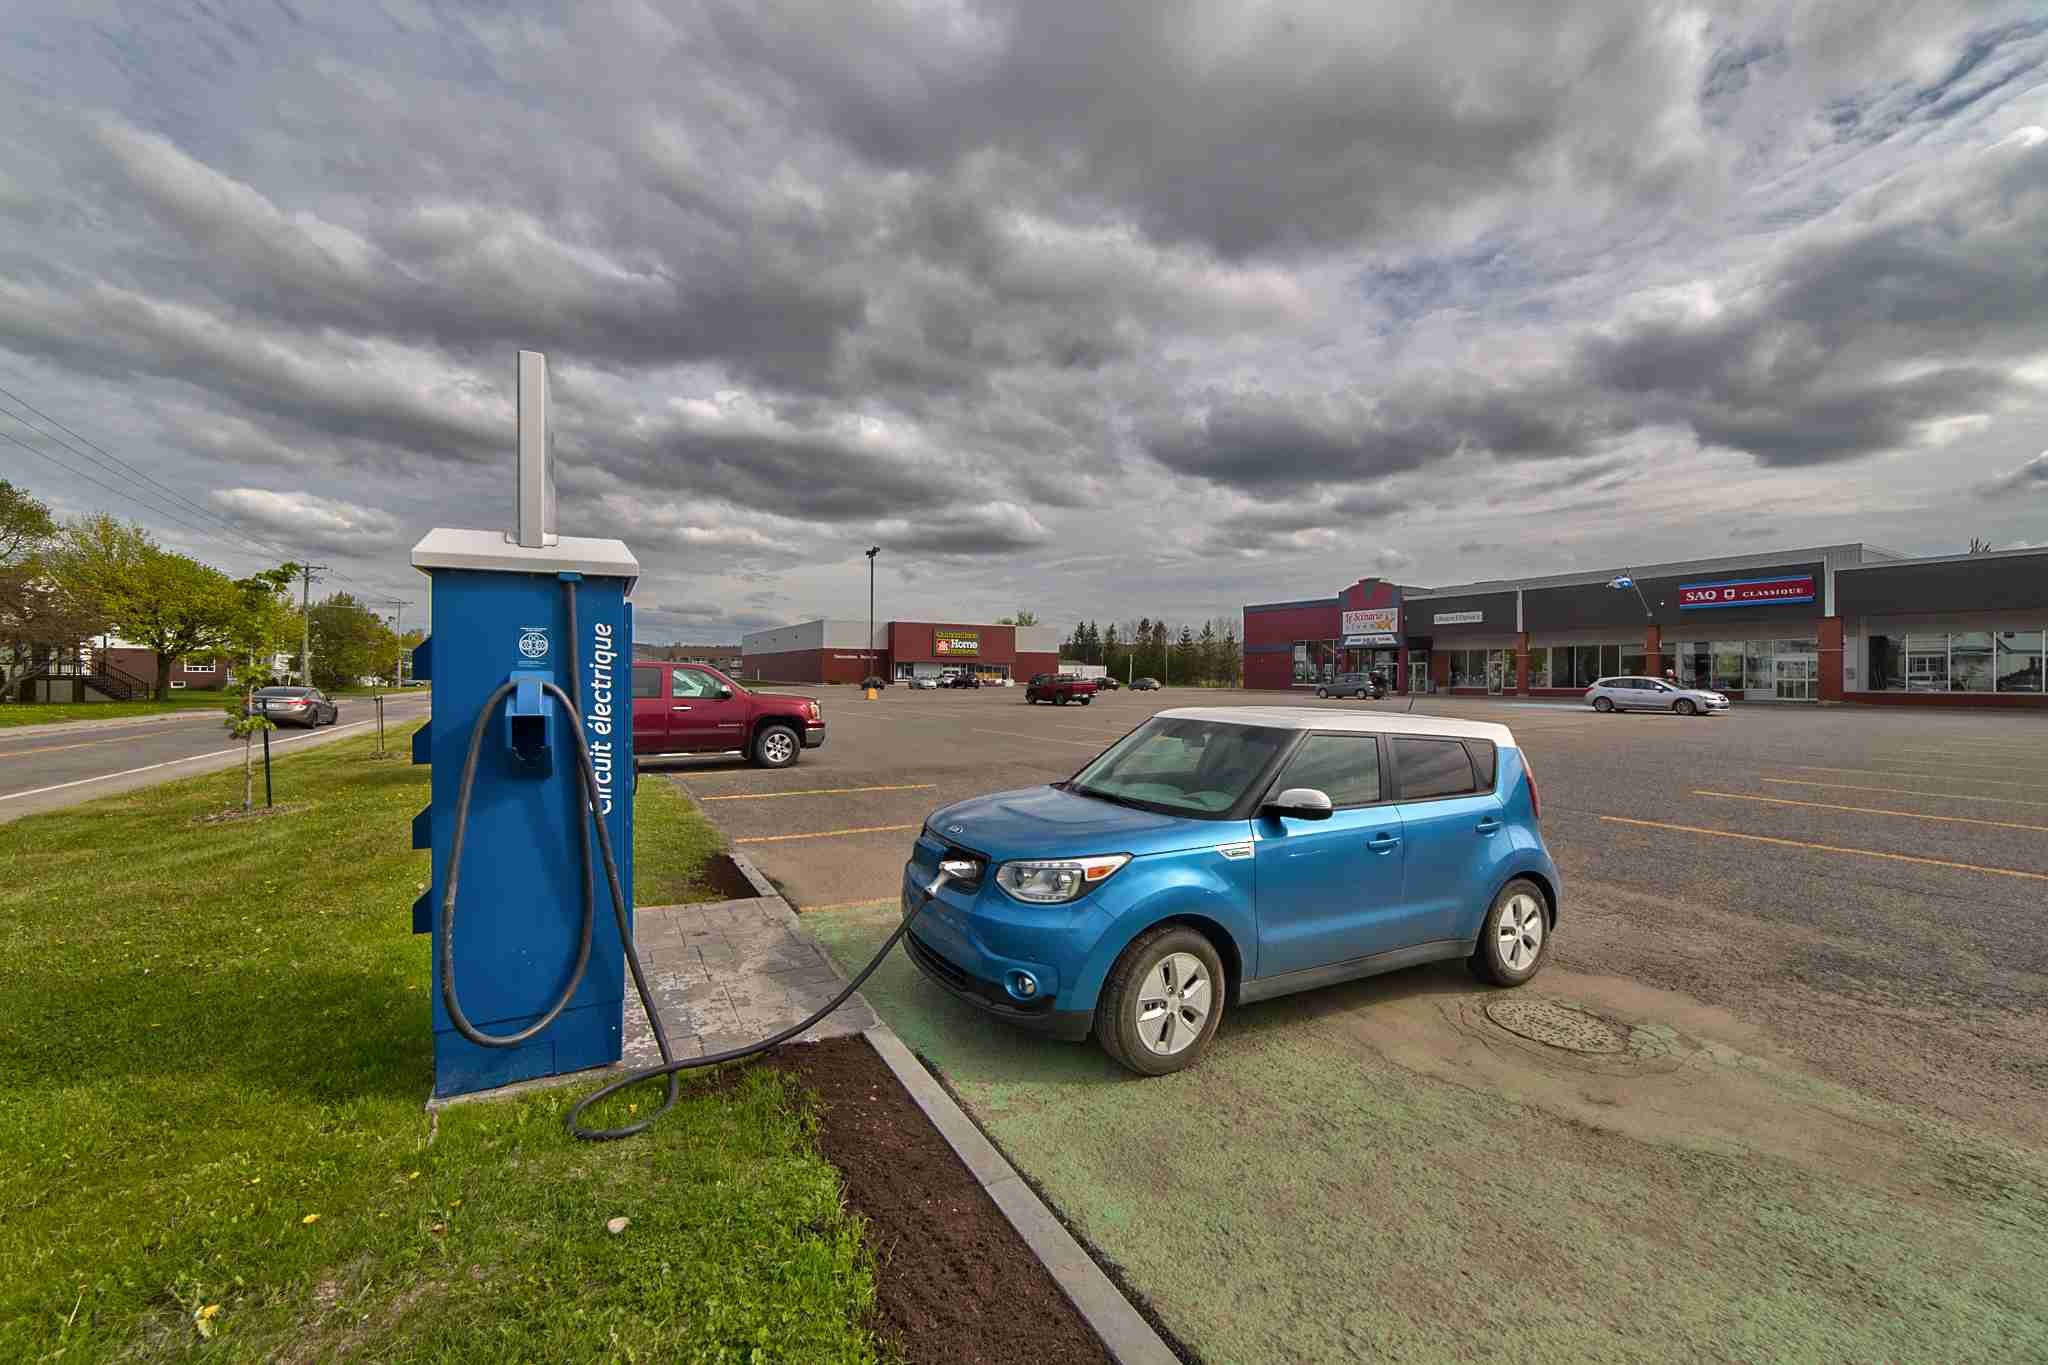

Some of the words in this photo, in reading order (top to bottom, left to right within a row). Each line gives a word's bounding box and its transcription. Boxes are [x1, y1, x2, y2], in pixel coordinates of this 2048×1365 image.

[1742, 587, 1804, 598] CLASSIQUE
[950, 638, 978, 649] Home
[588, 622, 617, 735] électrique
